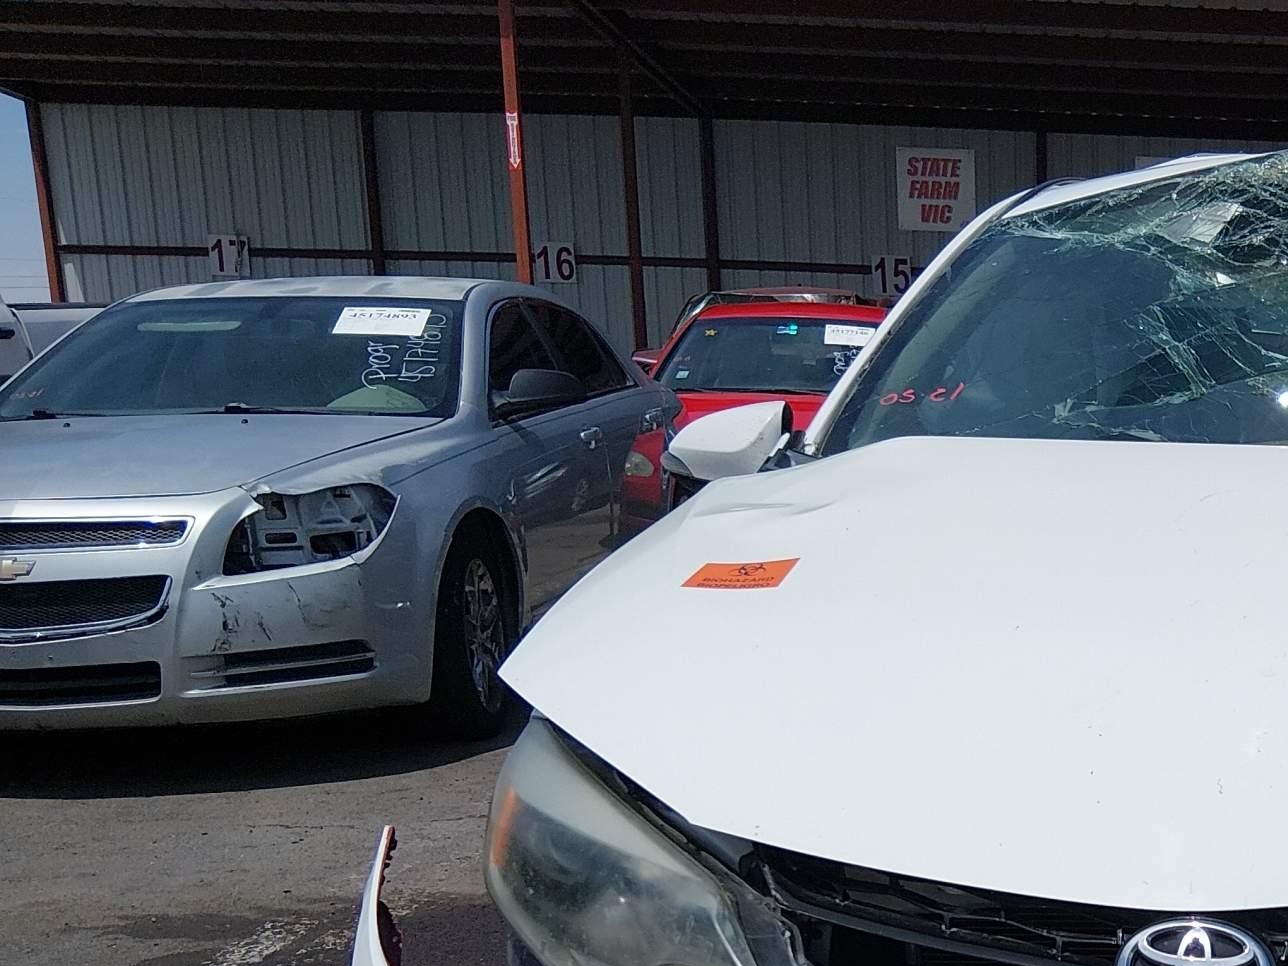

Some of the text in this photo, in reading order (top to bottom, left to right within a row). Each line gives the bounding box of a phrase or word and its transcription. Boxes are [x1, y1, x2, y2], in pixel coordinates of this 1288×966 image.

[906, 157, 962, 178] STATE
[908, 180, 960, 201] FARM
[920, 203, 954, 225] VIC
[210, 238, 247, 273] 17
[536, 245, 575, 281] 16
[874, 256, 911, 294] 15
